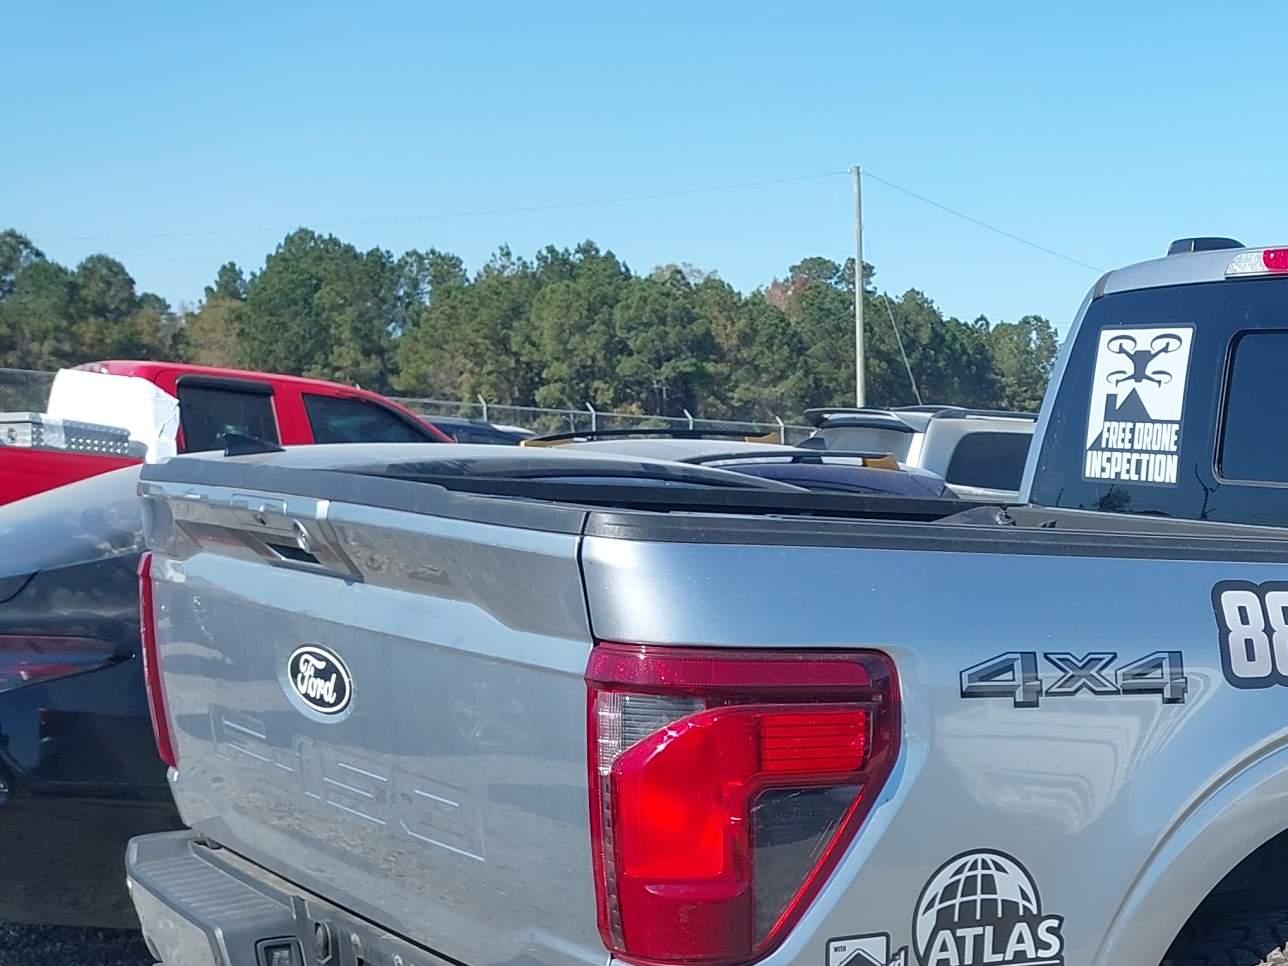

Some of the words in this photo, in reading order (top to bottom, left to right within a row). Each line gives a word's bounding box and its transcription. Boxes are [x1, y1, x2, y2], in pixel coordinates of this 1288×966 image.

[1101, 421, 1134, 449] FREE
[1133, 422, 1180, 452] DRONE
[1085, 450, 1178, 484] INSPECTION
[296, 653, 337, 704] Ford
